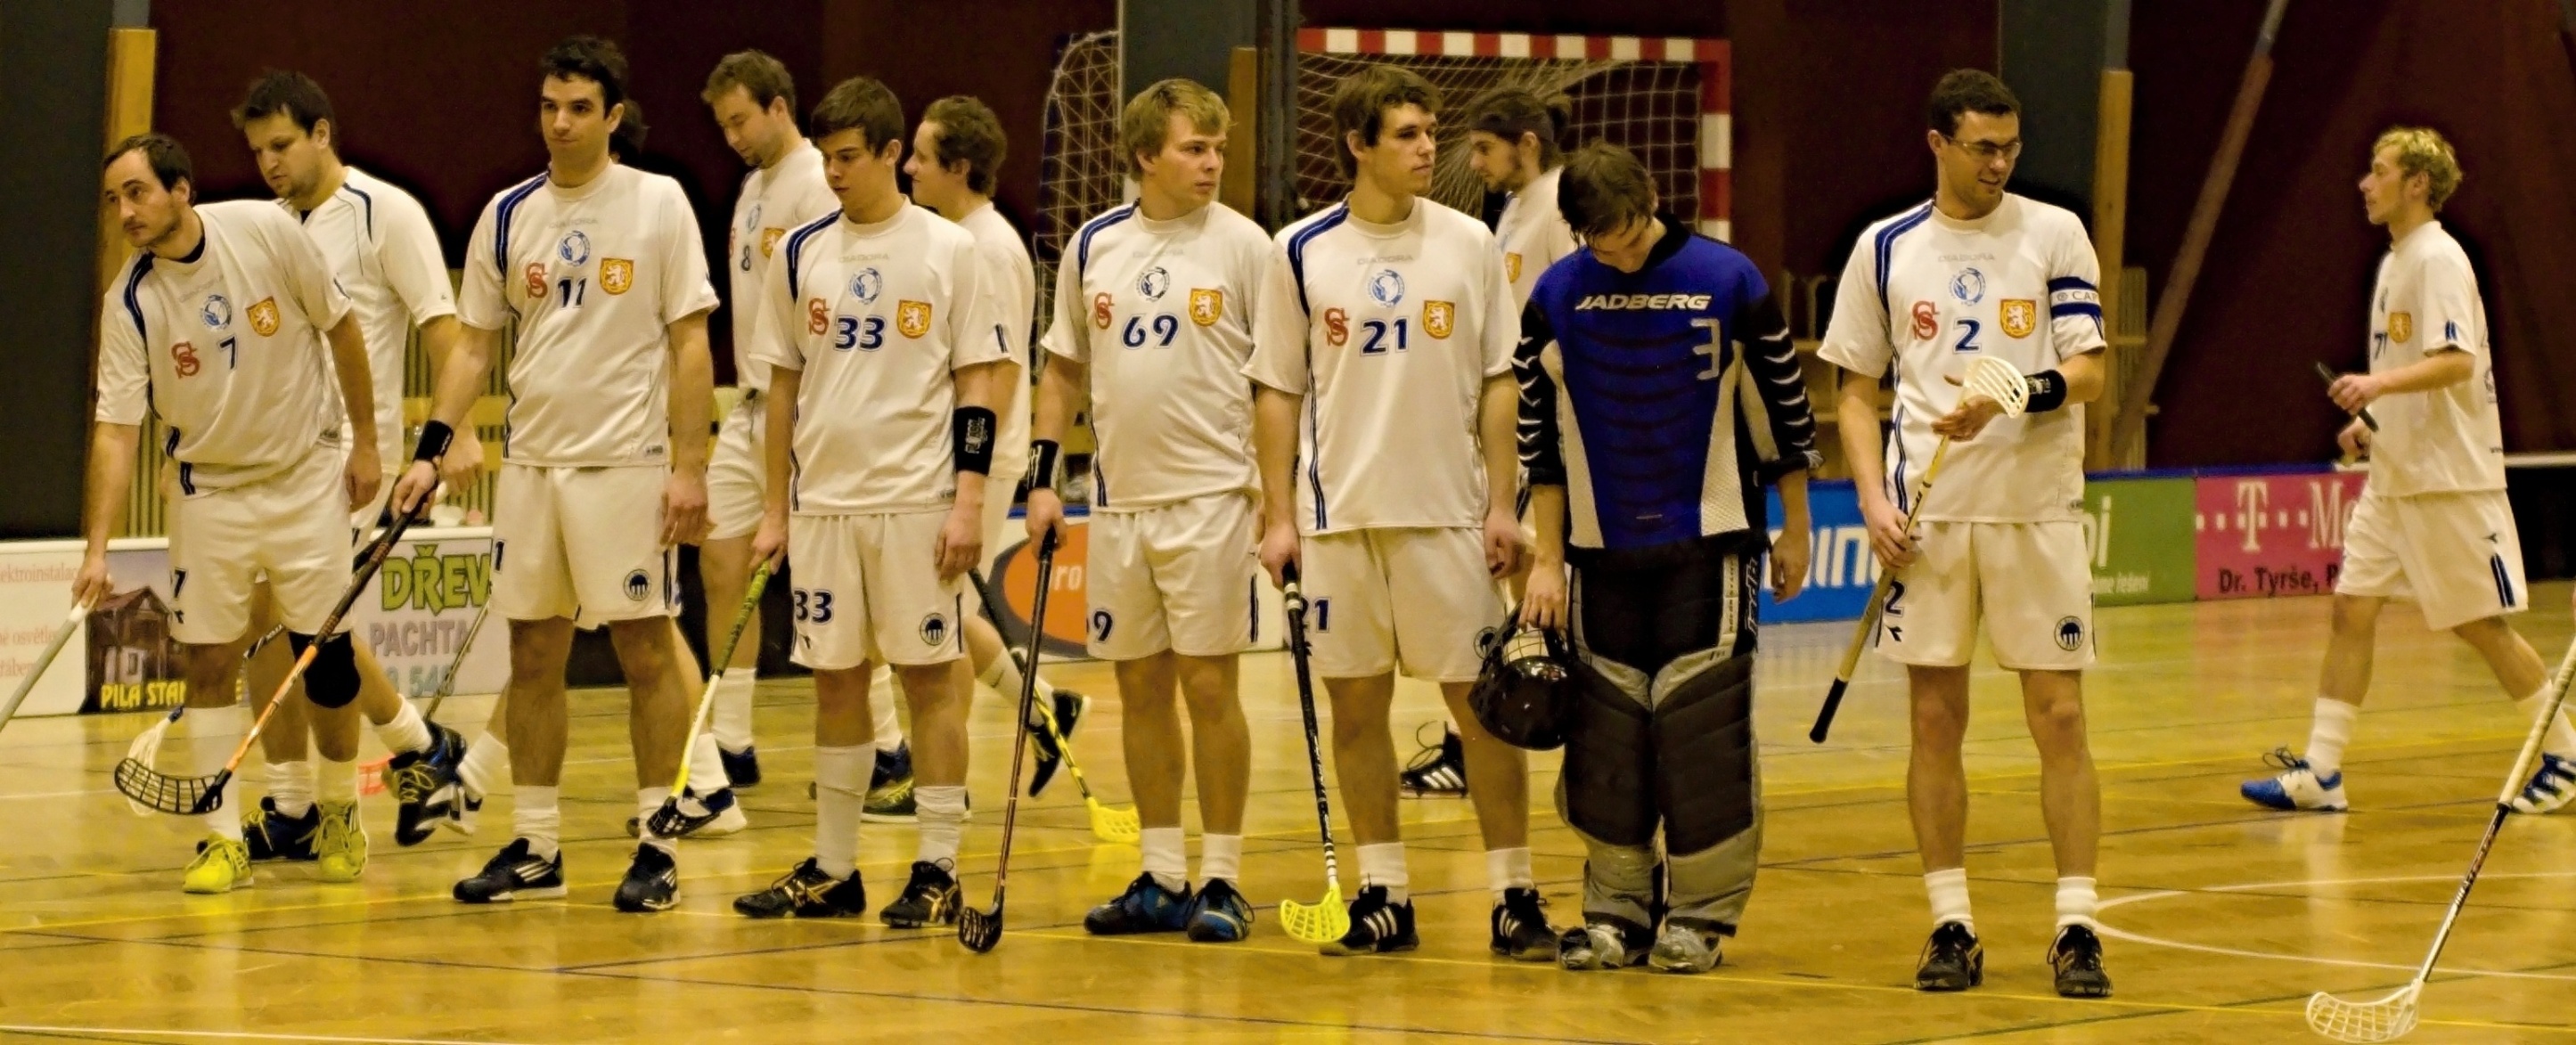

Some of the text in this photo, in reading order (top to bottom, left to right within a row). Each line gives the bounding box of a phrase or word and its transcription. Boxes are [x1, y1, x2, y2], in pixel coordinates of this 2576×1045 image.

[557, 278, 588, 308] 11
[1575, 293, 1712, 311] JADBERG
[834, 315, 887, 351] 33
[1121, 313, 1181, 349] 69
[1361, 316, 1411, 355] 21
[1689, 317, 1721, 380] 3
[1954, 316, 1982, 354] 2
[218, 335, 238, 371] 7
[174, 567, 186, 599] 7
[1885, 579, 1906, 616] 2
[2219, 567, 2245, 594] Dr.
[794, 589, 834, 624] 33
[369, 621, 471, 657] PACHTA
[101, 683, 141, 709] PILA
